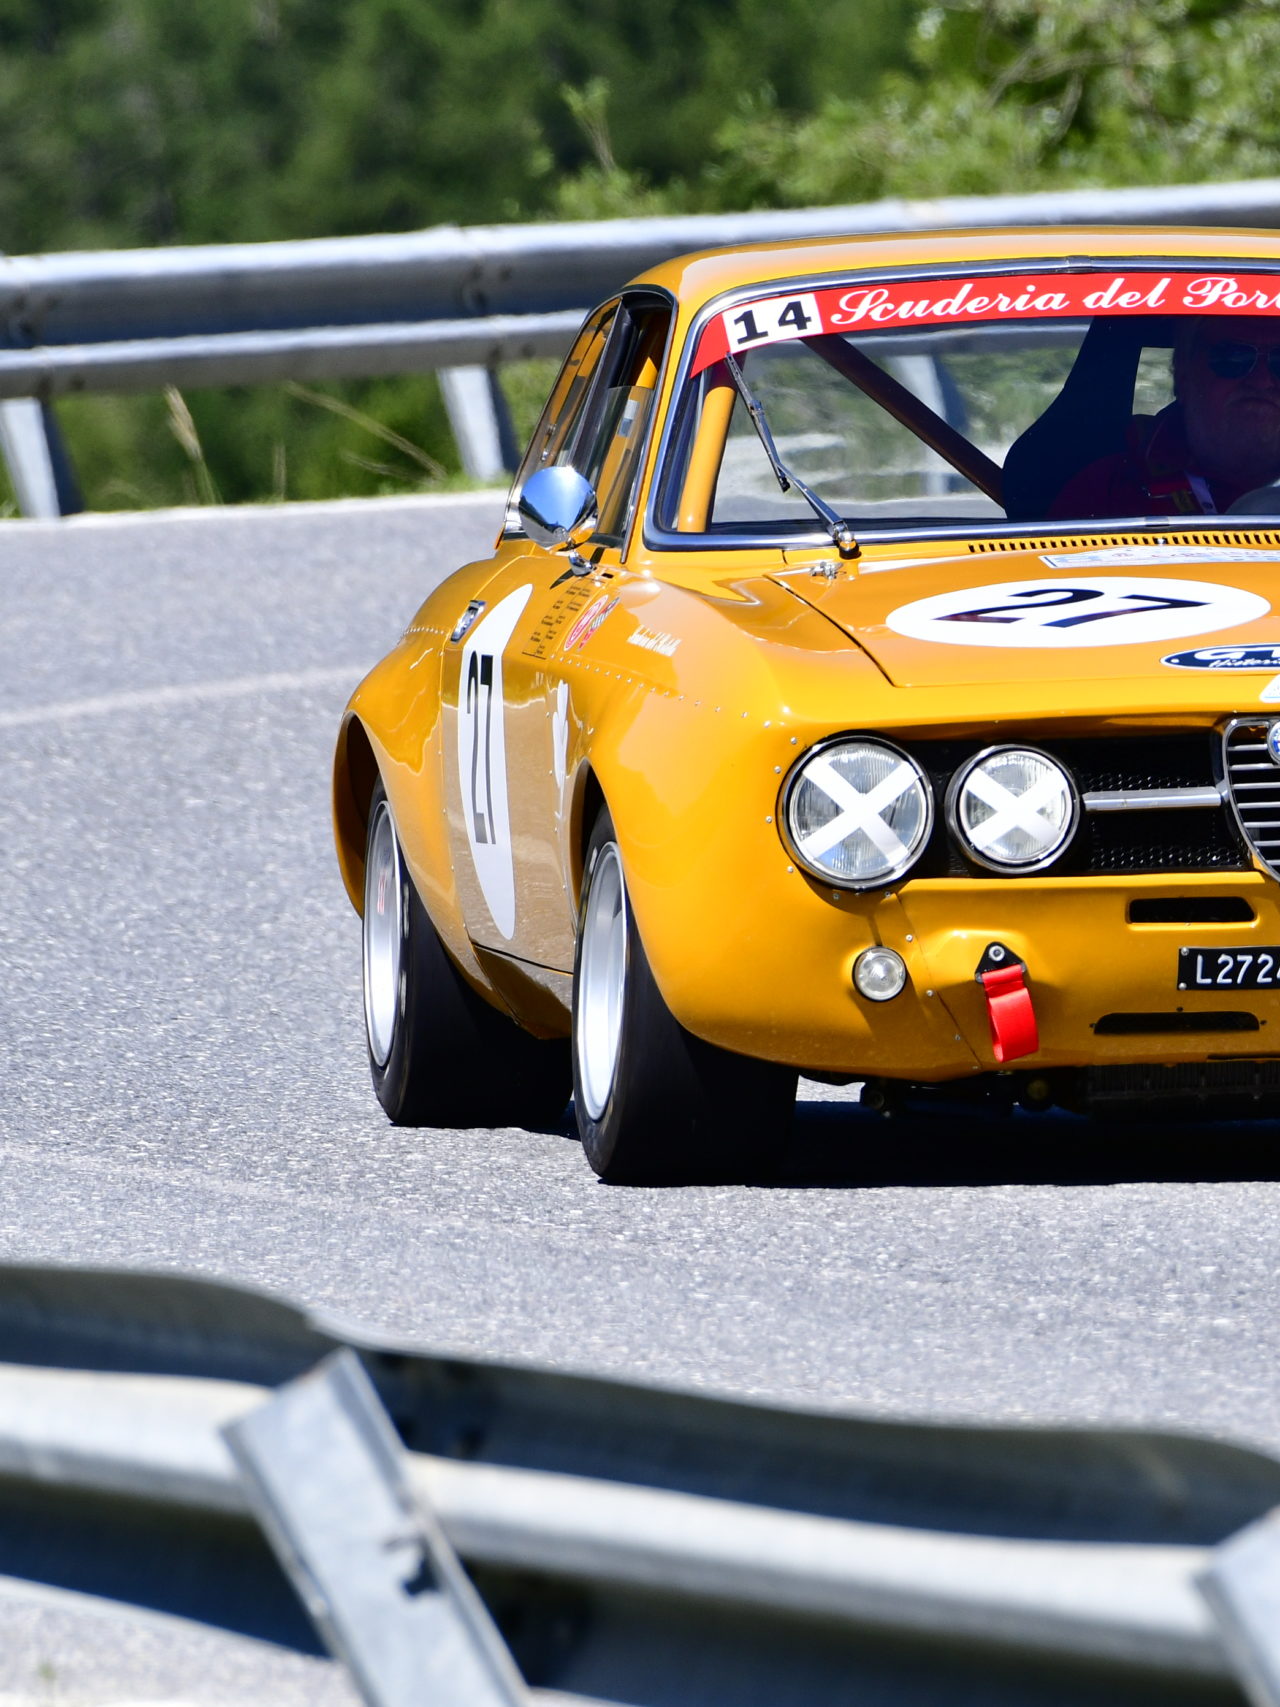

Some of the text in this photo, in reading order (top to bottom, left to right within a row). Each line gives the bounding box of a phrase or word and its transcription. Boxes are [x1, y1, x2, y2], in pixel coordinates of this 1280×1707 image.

[734, 300, 812, 344] 14
[831, 284, 1069, 324] Scuderia
[1083, 277, 1171, 309] del
[932, 588, 1213, 628] 27
[467, 650, 496, 844] 27
